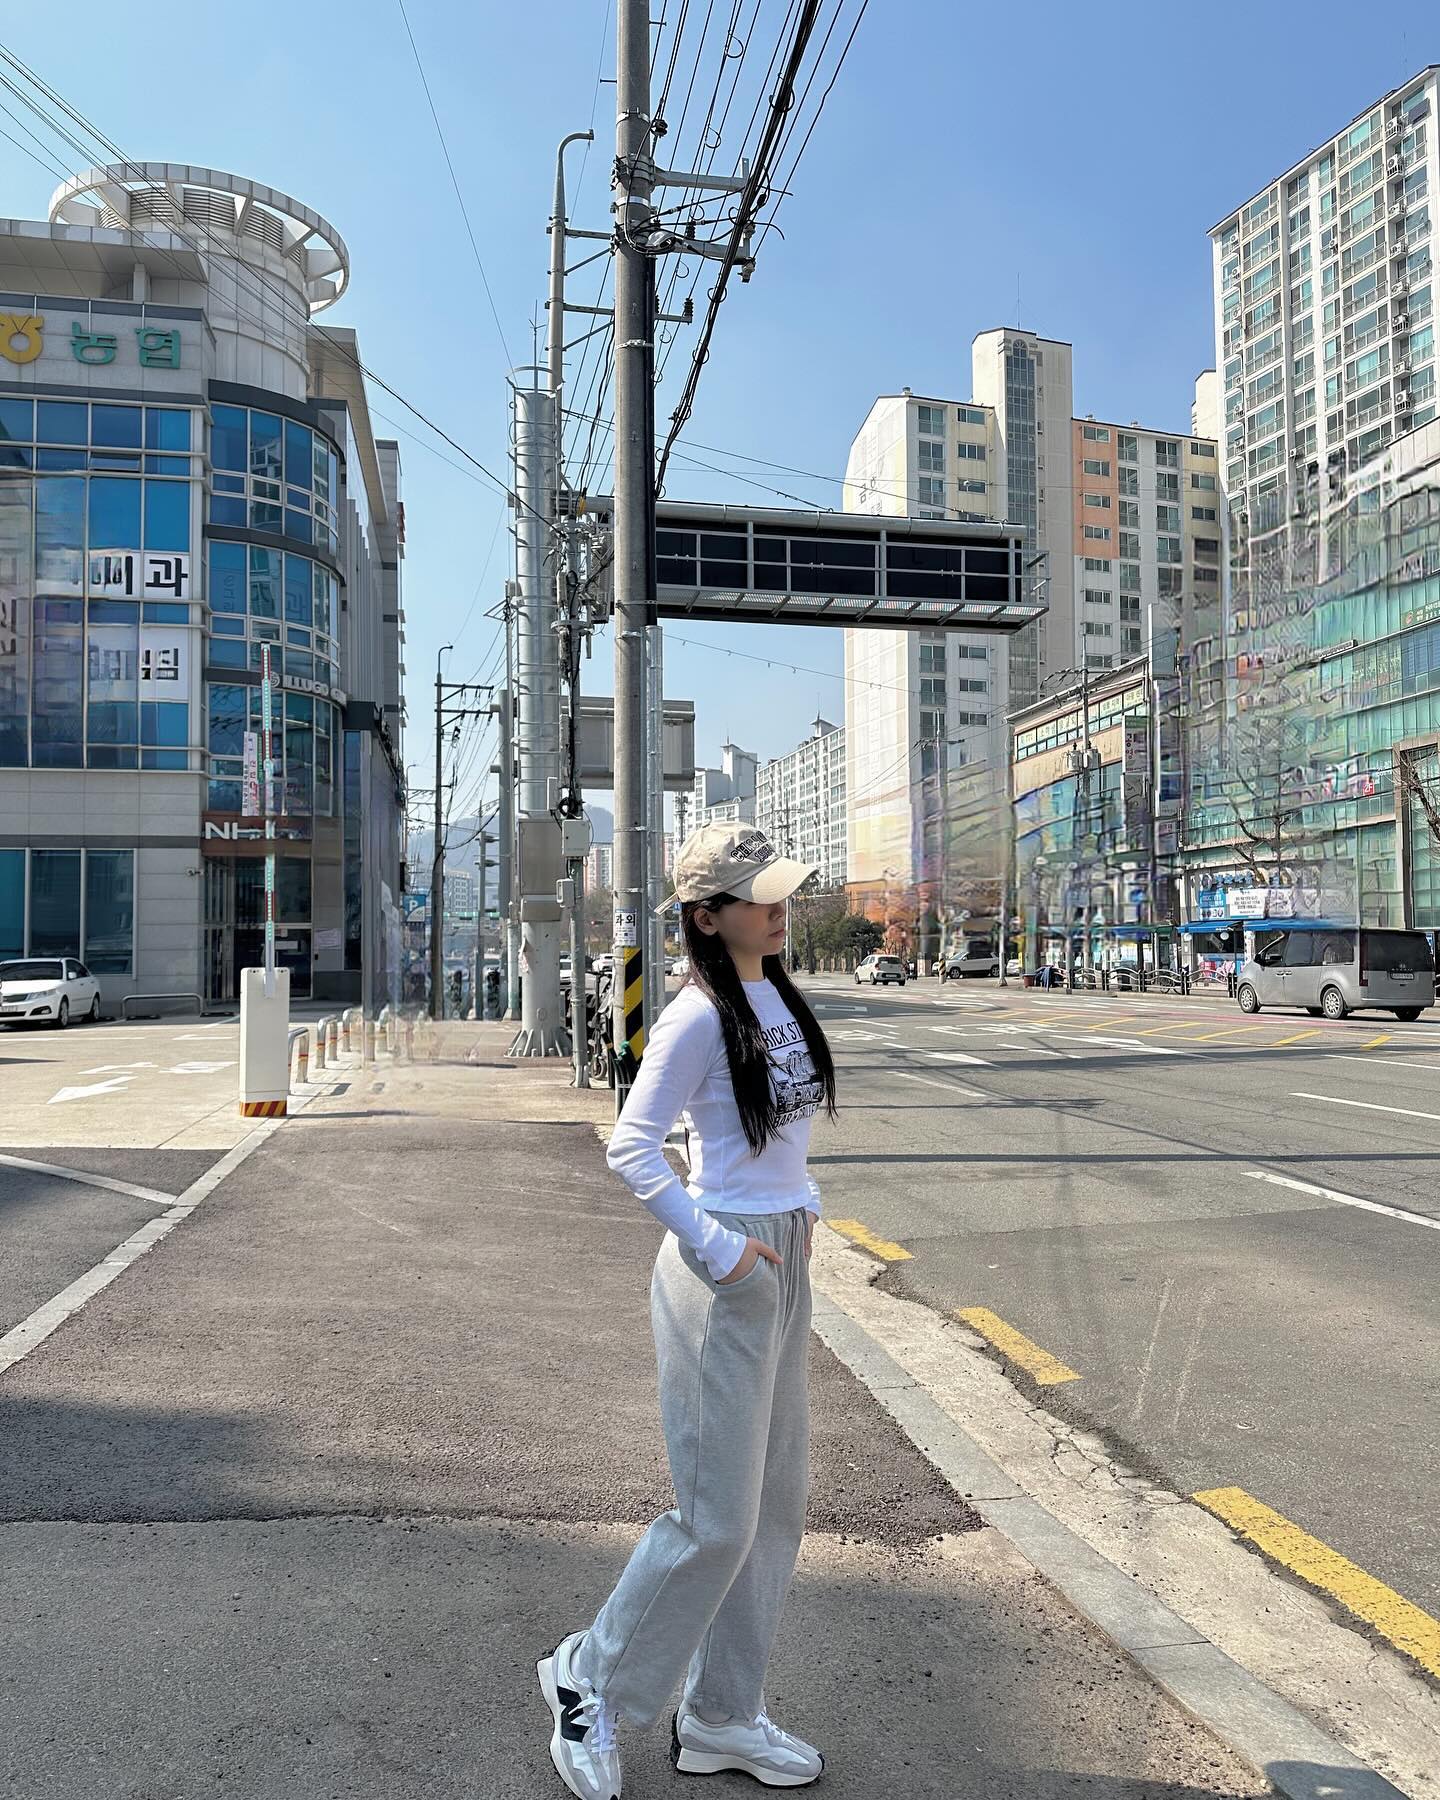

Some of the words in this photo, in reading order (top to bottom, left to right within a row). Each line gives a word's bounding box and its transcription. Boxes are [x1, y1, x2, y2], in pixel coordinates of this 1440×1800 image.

[70, 321, 181, 369] 농협
[615, 914, 636, 927] 과외
[761, 1025, 790, 1048] RICK
